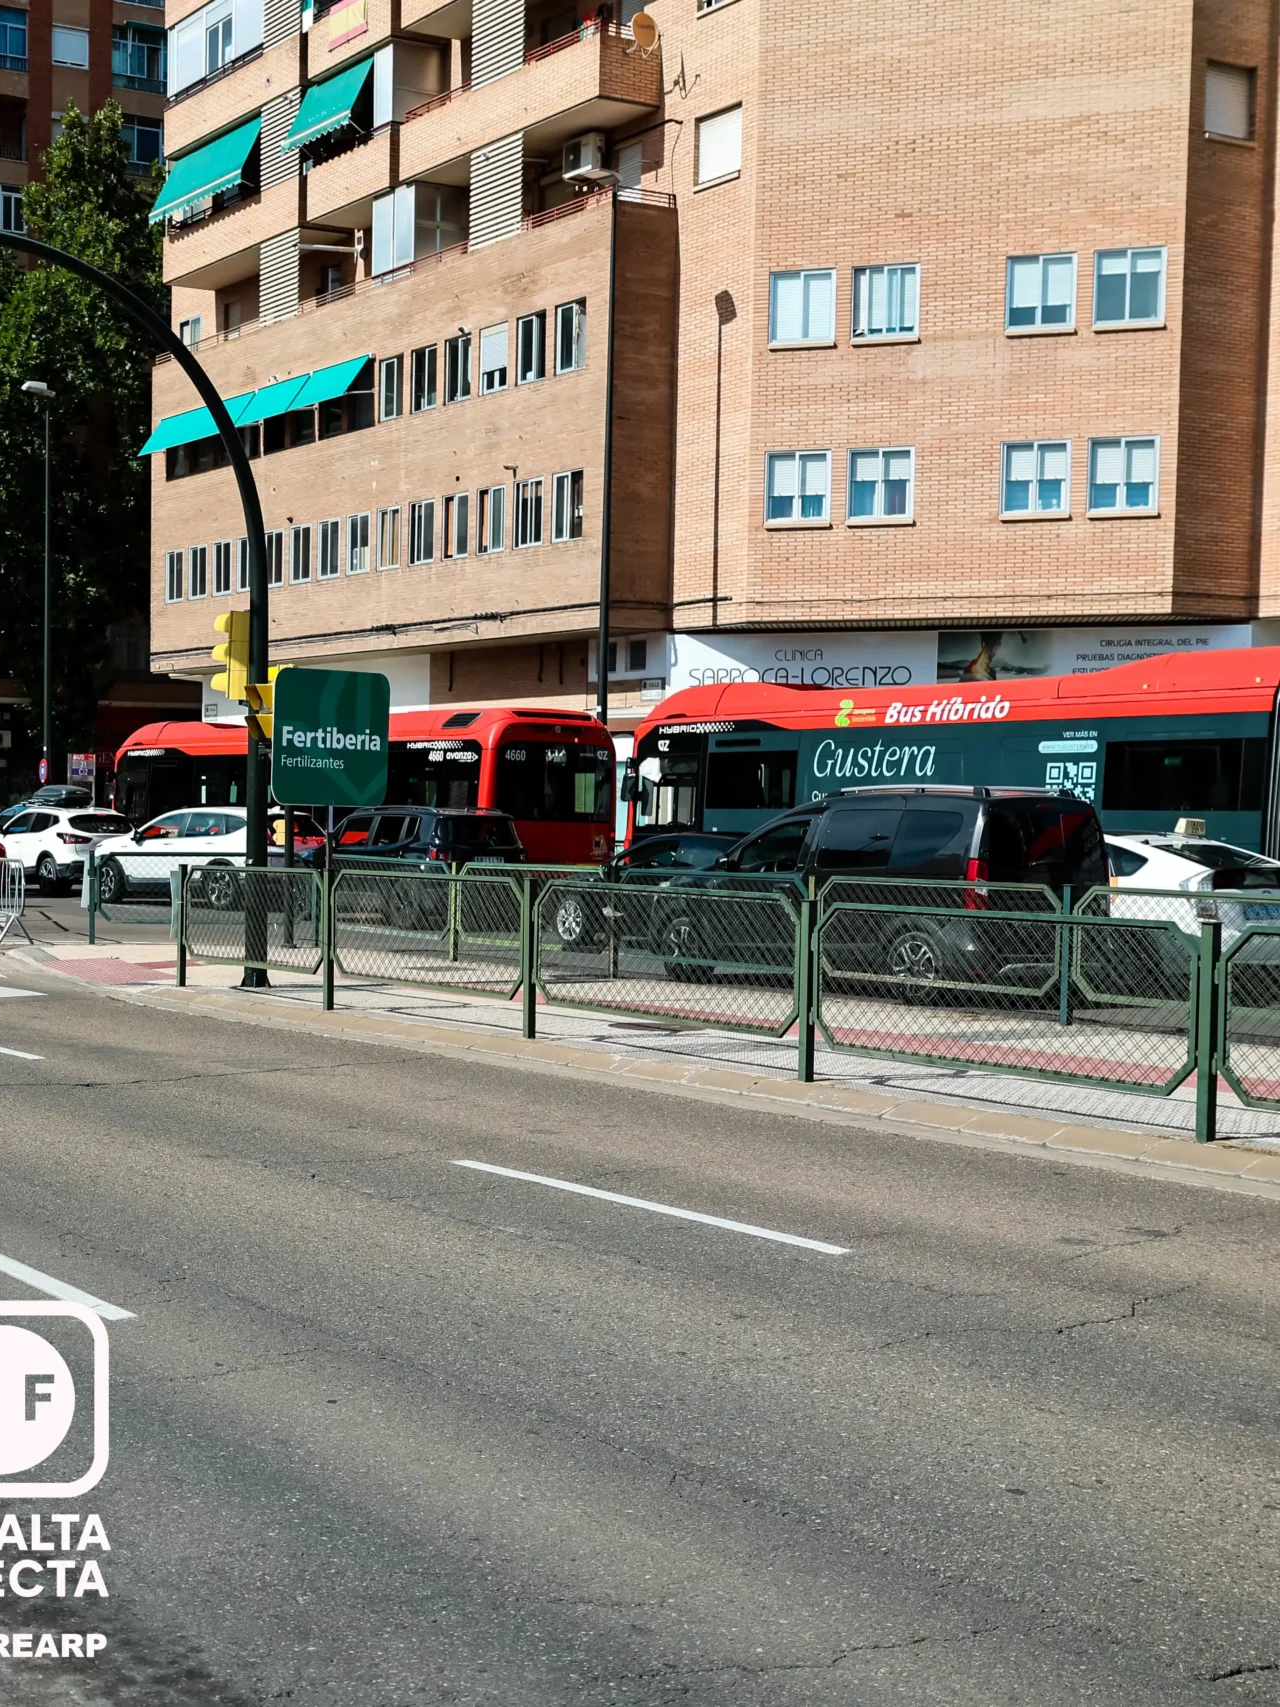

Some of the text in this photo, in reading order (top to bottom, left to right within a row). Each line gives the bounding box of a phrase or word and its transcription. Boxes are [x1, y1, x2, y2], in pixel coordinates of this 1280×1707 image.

[1135, 638, 1174, 647] INTEGRAL
[1177, 638, 1193, 646] DEL
[1196, 637, 1209, 646] PIE
[775, 649, 823, 662] CLINICA
[1076, 653, 1115, 662] PRUEBAS
[884, 695, 1010, 723] Bus Híbrido
[659, 725, 697, 734] HYBRID
[1075, 730, 1089, 738] MÁS
[1089, 730, 1098, 738] EN
[282, 725, 381, 751] Fertiberia
[428, 750, 472, 762] 4660 avanza
[505, 749, 526, 761] 4660
[813, 739, 936, 778] Gustera
[281, 754, 344, 769] Fertilizantes
